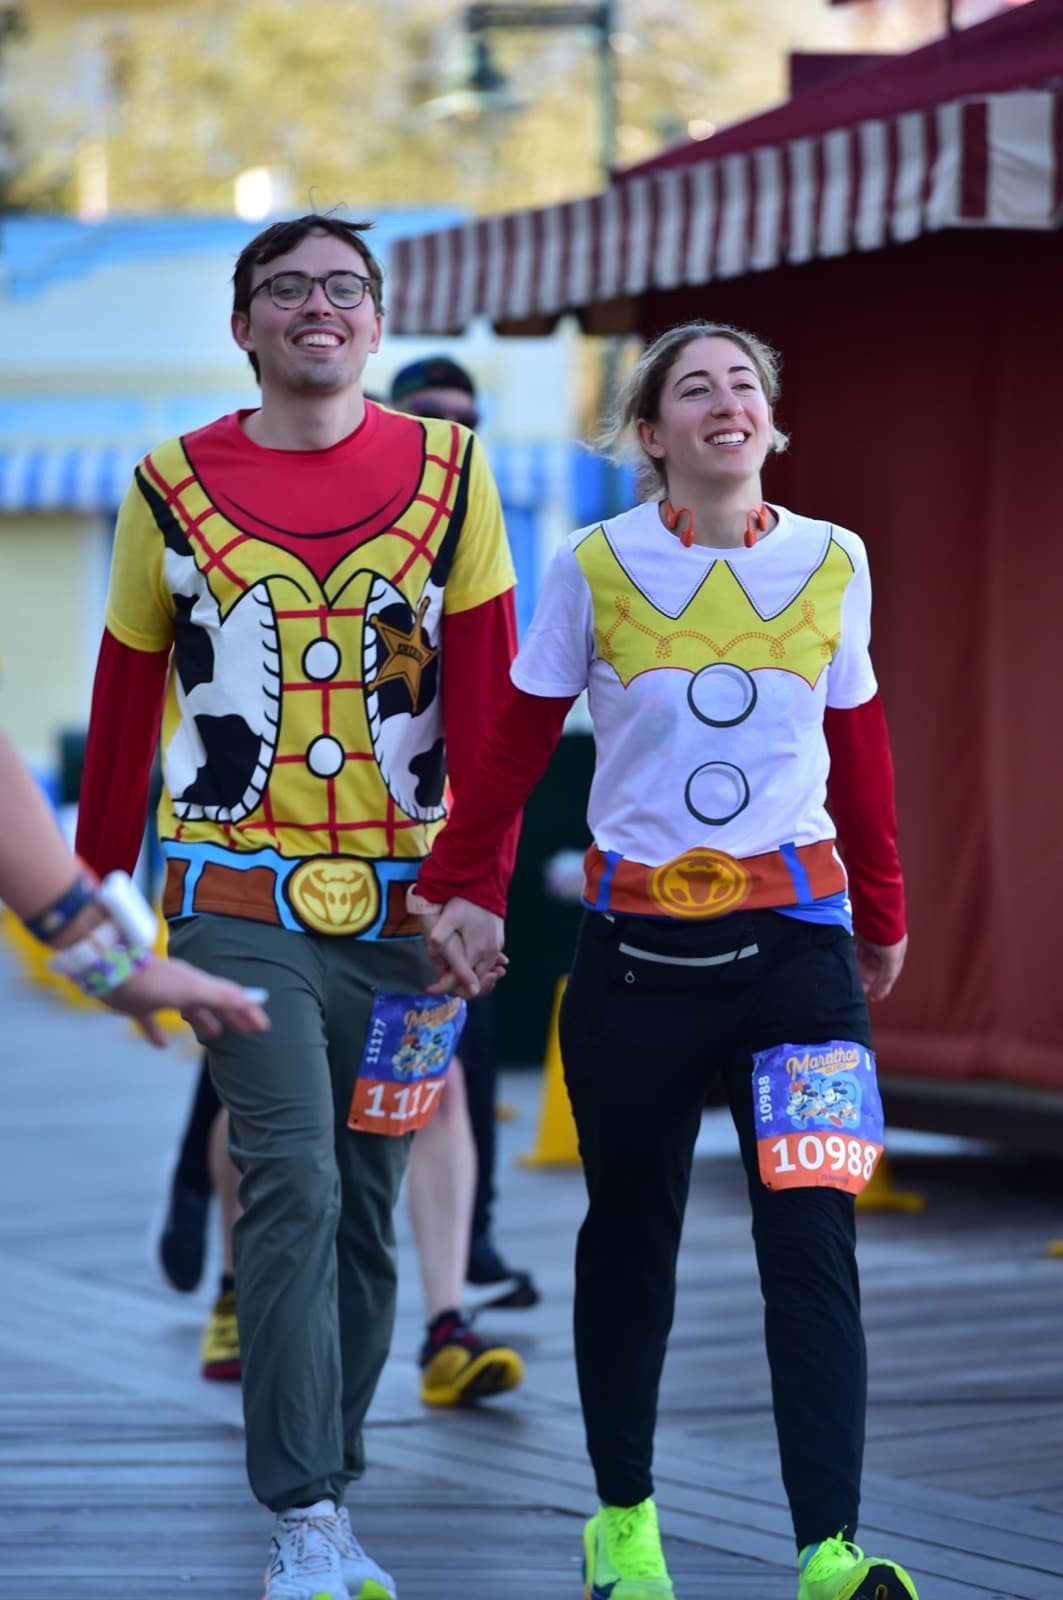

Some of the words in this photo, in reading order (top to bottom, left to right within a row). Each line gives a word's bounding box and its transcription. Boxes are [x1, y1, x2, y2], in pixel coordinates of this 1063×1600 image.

[365, 1018, 387, 1064] 11177
[364, 1080, 446, 1120] 1117
[758, 1075, 773, 1123] 10988
[771, 1135, 877, 1181] 10988
